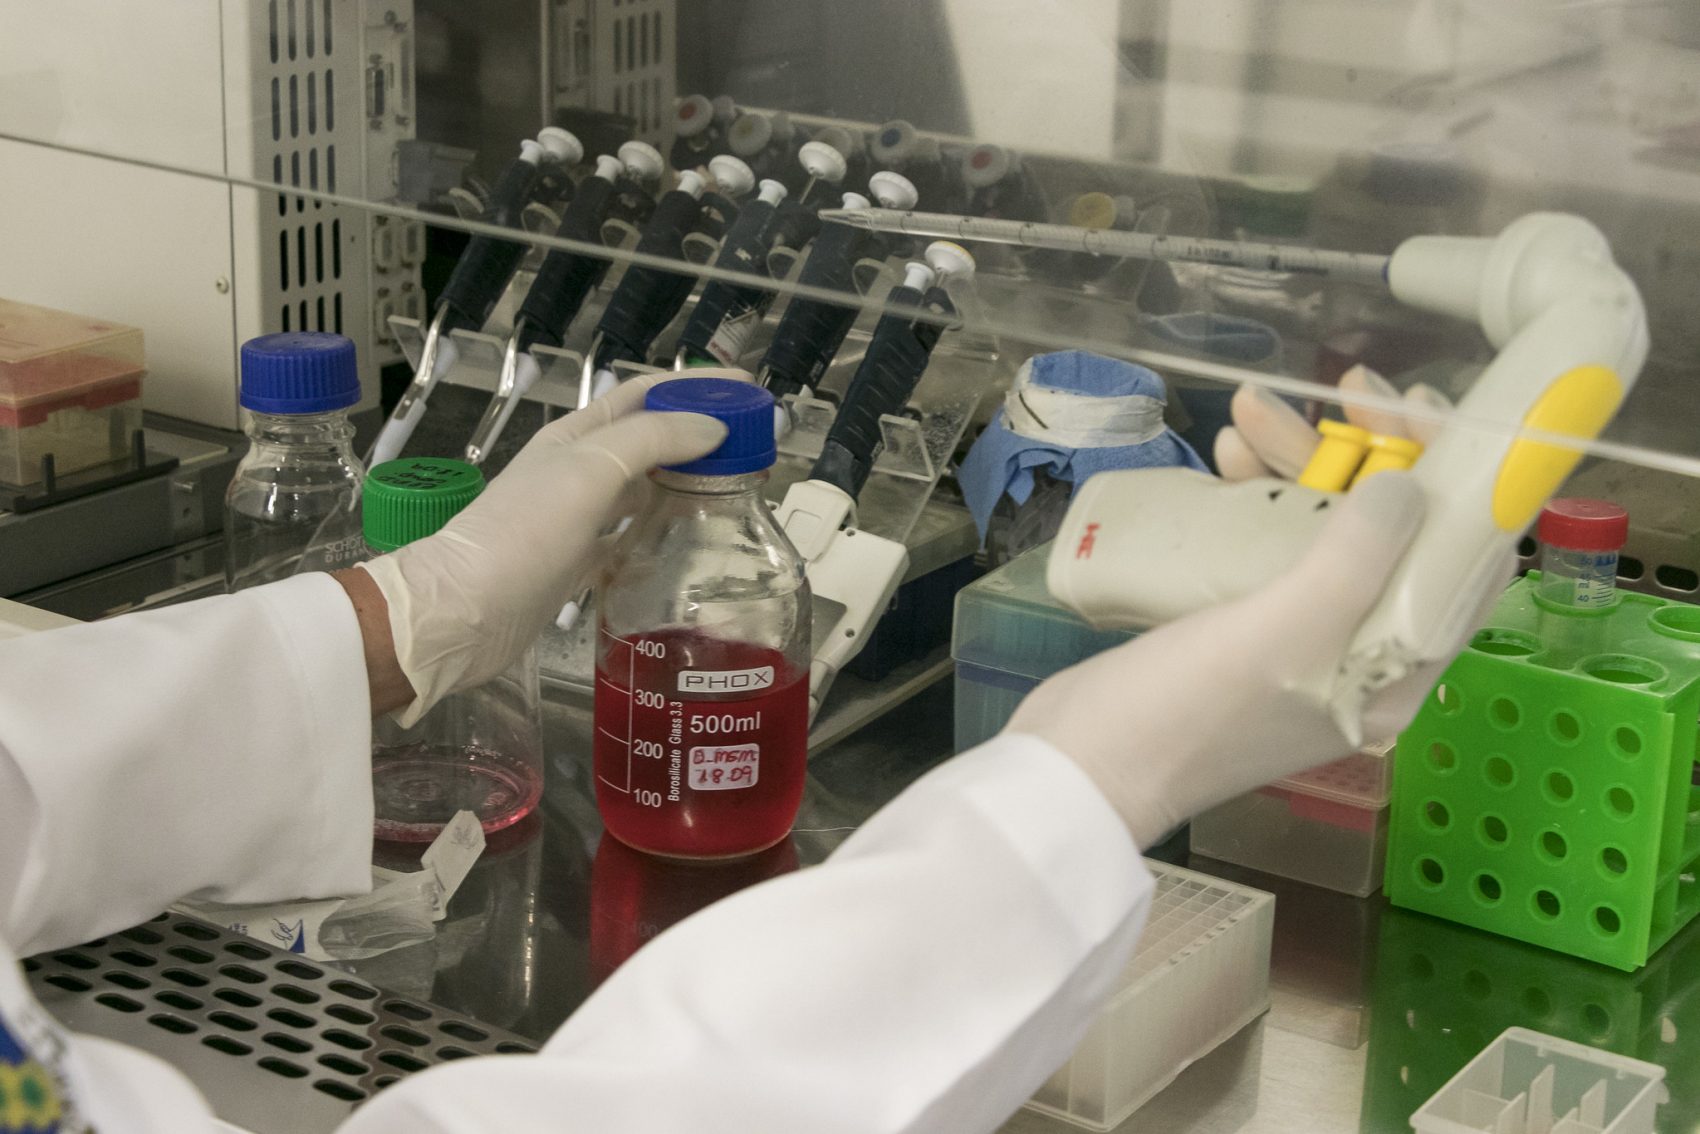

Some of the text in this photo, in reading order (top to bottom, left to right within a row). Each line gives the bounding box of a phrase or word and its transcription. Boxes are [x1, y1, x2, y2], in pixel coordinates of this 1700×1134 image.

[325, 535, 364, 553] SCHOT
[635, 639, 666, 659] 400
[685, 670, 769, 688] PHOX
[634, 689, 665, 709] 300
[689, 711, 761, 734] 500ml
[633, 739, 664, 759] 200
[667, 701, 684, 802] Borosilicate Glass 3.3
[633, 788, 662, 808] 100
